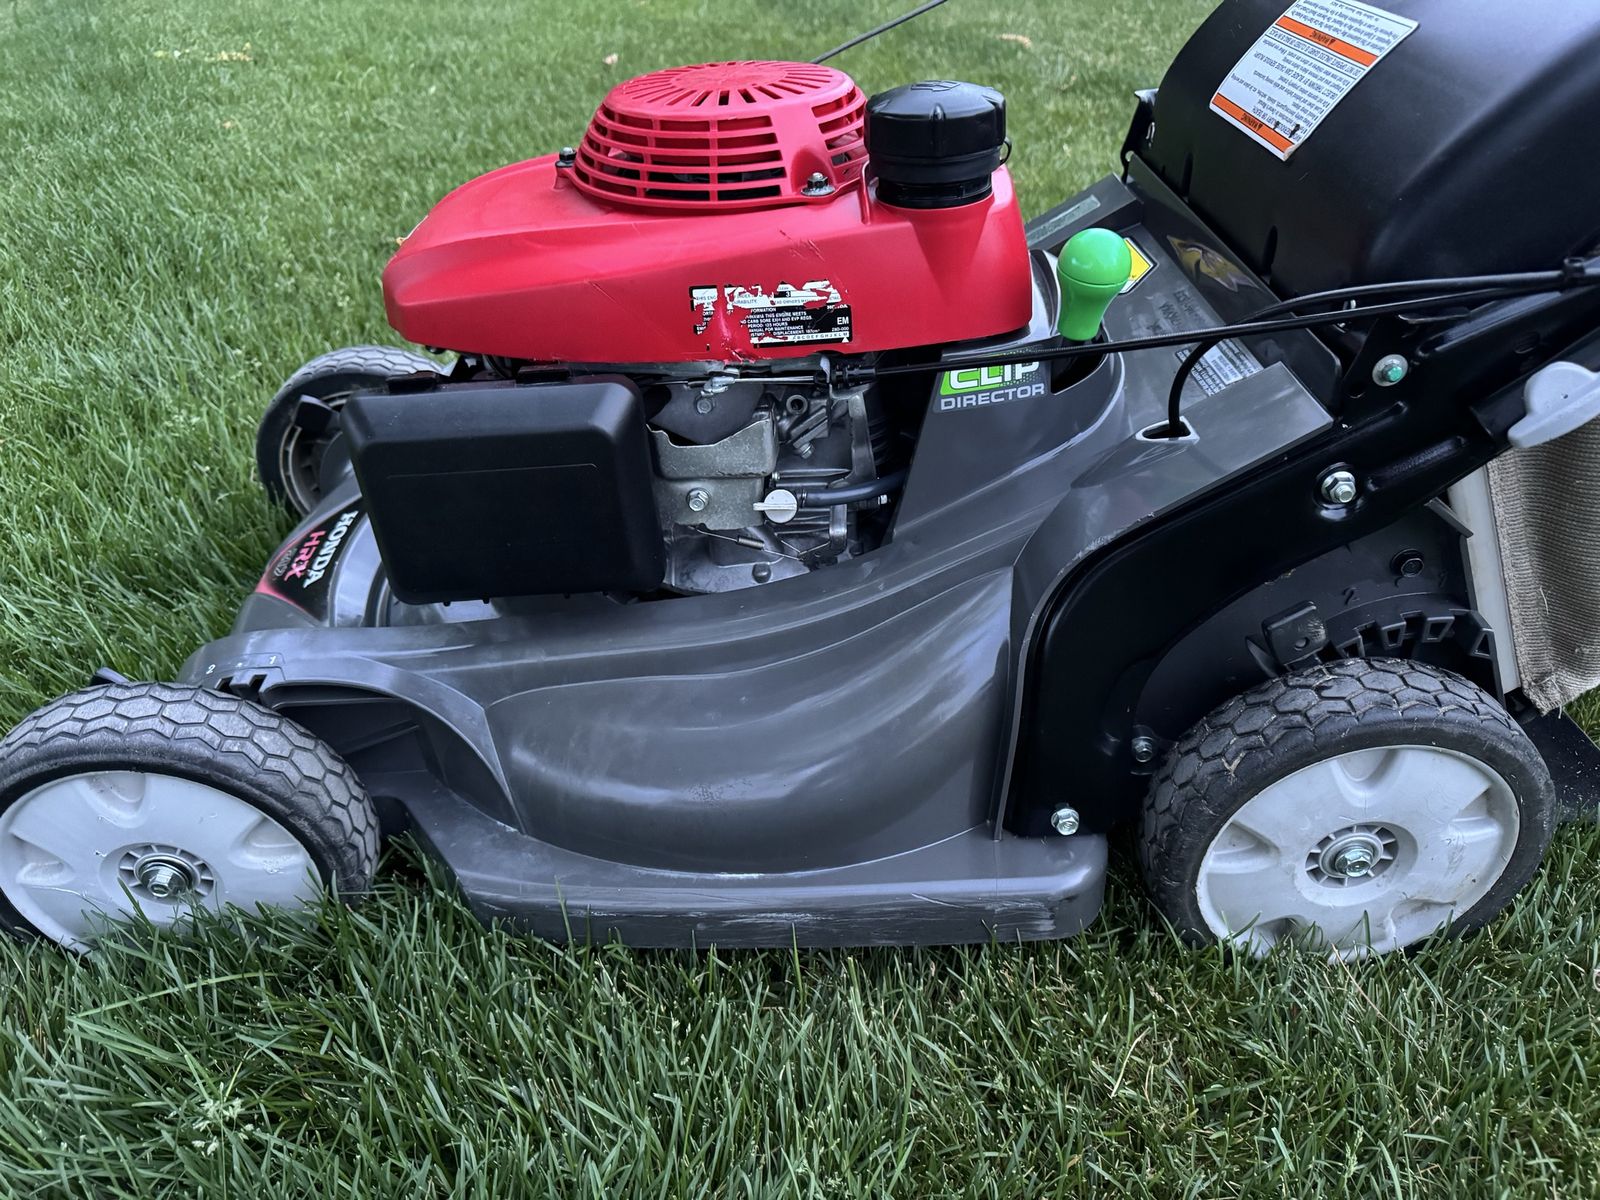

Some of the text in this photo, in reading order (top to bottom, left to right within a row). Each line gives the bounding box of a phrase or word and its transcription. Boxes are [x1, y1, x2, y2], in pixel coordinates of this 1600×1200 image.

[1308, 30, 1331, 44] WARNING
[1239, 112, 1260, 129] WARNING
[837, 317, 849, 325] EM
[950, 361, 1040, 389] CLIP
[940, 382, 1045, 411] DIRECTOR
[284, 531, 327, 581] HRX
[303, 511, 359, 588] HONDA
[206, 664, 216, 675] 2
